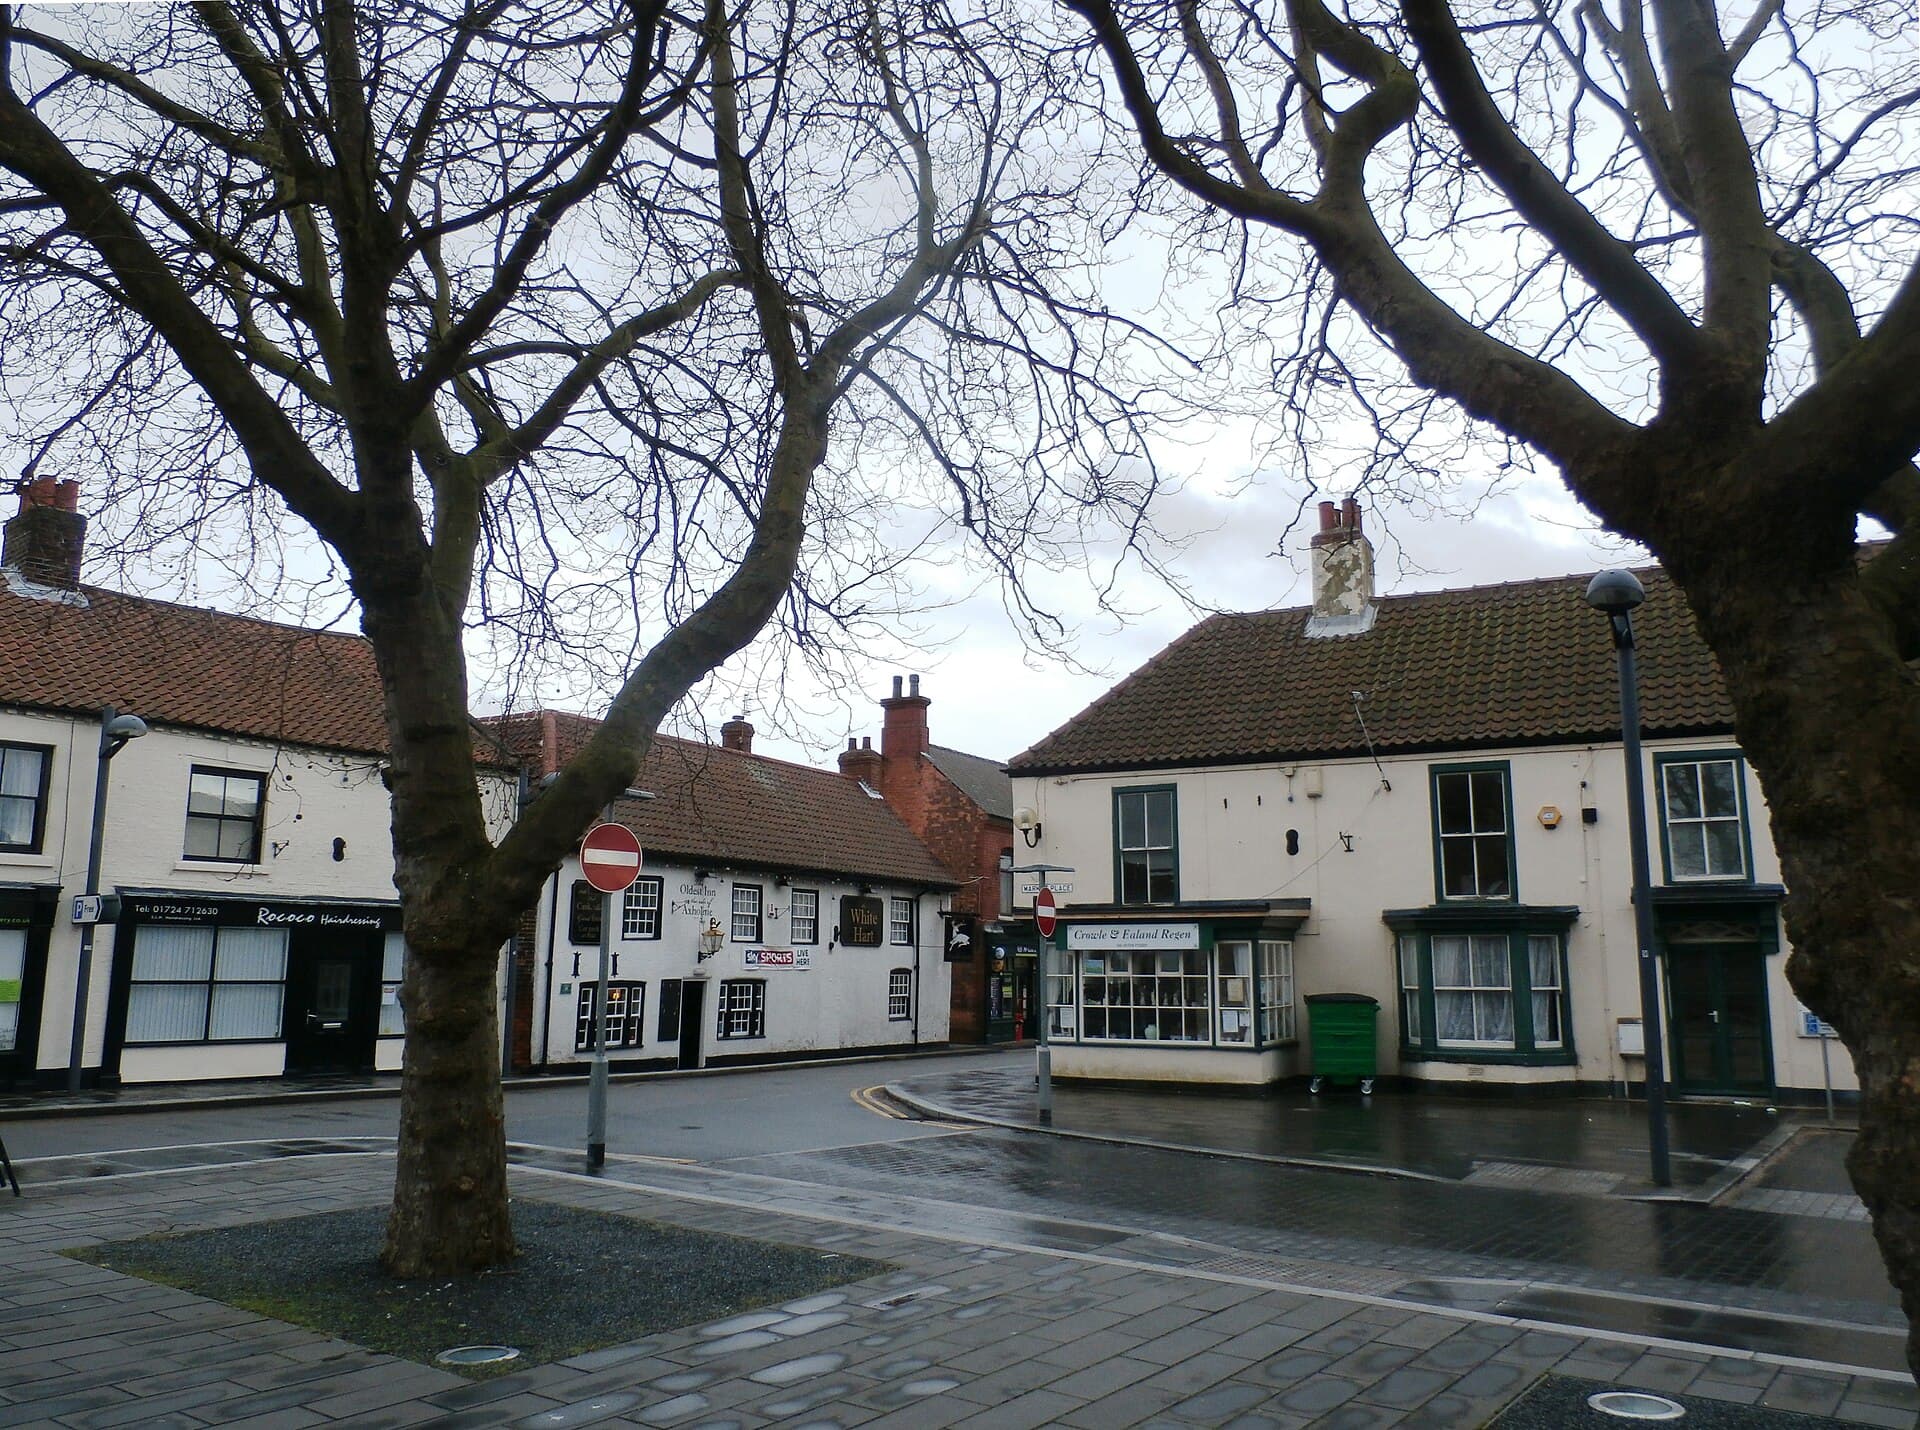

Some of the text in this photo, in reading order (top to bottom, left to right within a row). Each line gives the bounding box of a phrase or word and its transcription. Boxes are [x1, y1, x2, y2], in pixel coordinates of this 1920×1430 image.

[680, 884, 716, 896] Oldest Inn
[75, 902, 82, 918] P
[153, 905, 182, 914] 01724
[184, 906, 219, 915] 712630
[257, 907, 381, 929] Rococo Hairdressing
[850, 908, 878, 925] White
[853, 926, 874, 942] Hart
[1074, 928, 1191, 940] Crowle & Ealand Regen
[747, 951, 792, 963] sky SPORTS
[797, 949, 809, 957] LIVE
